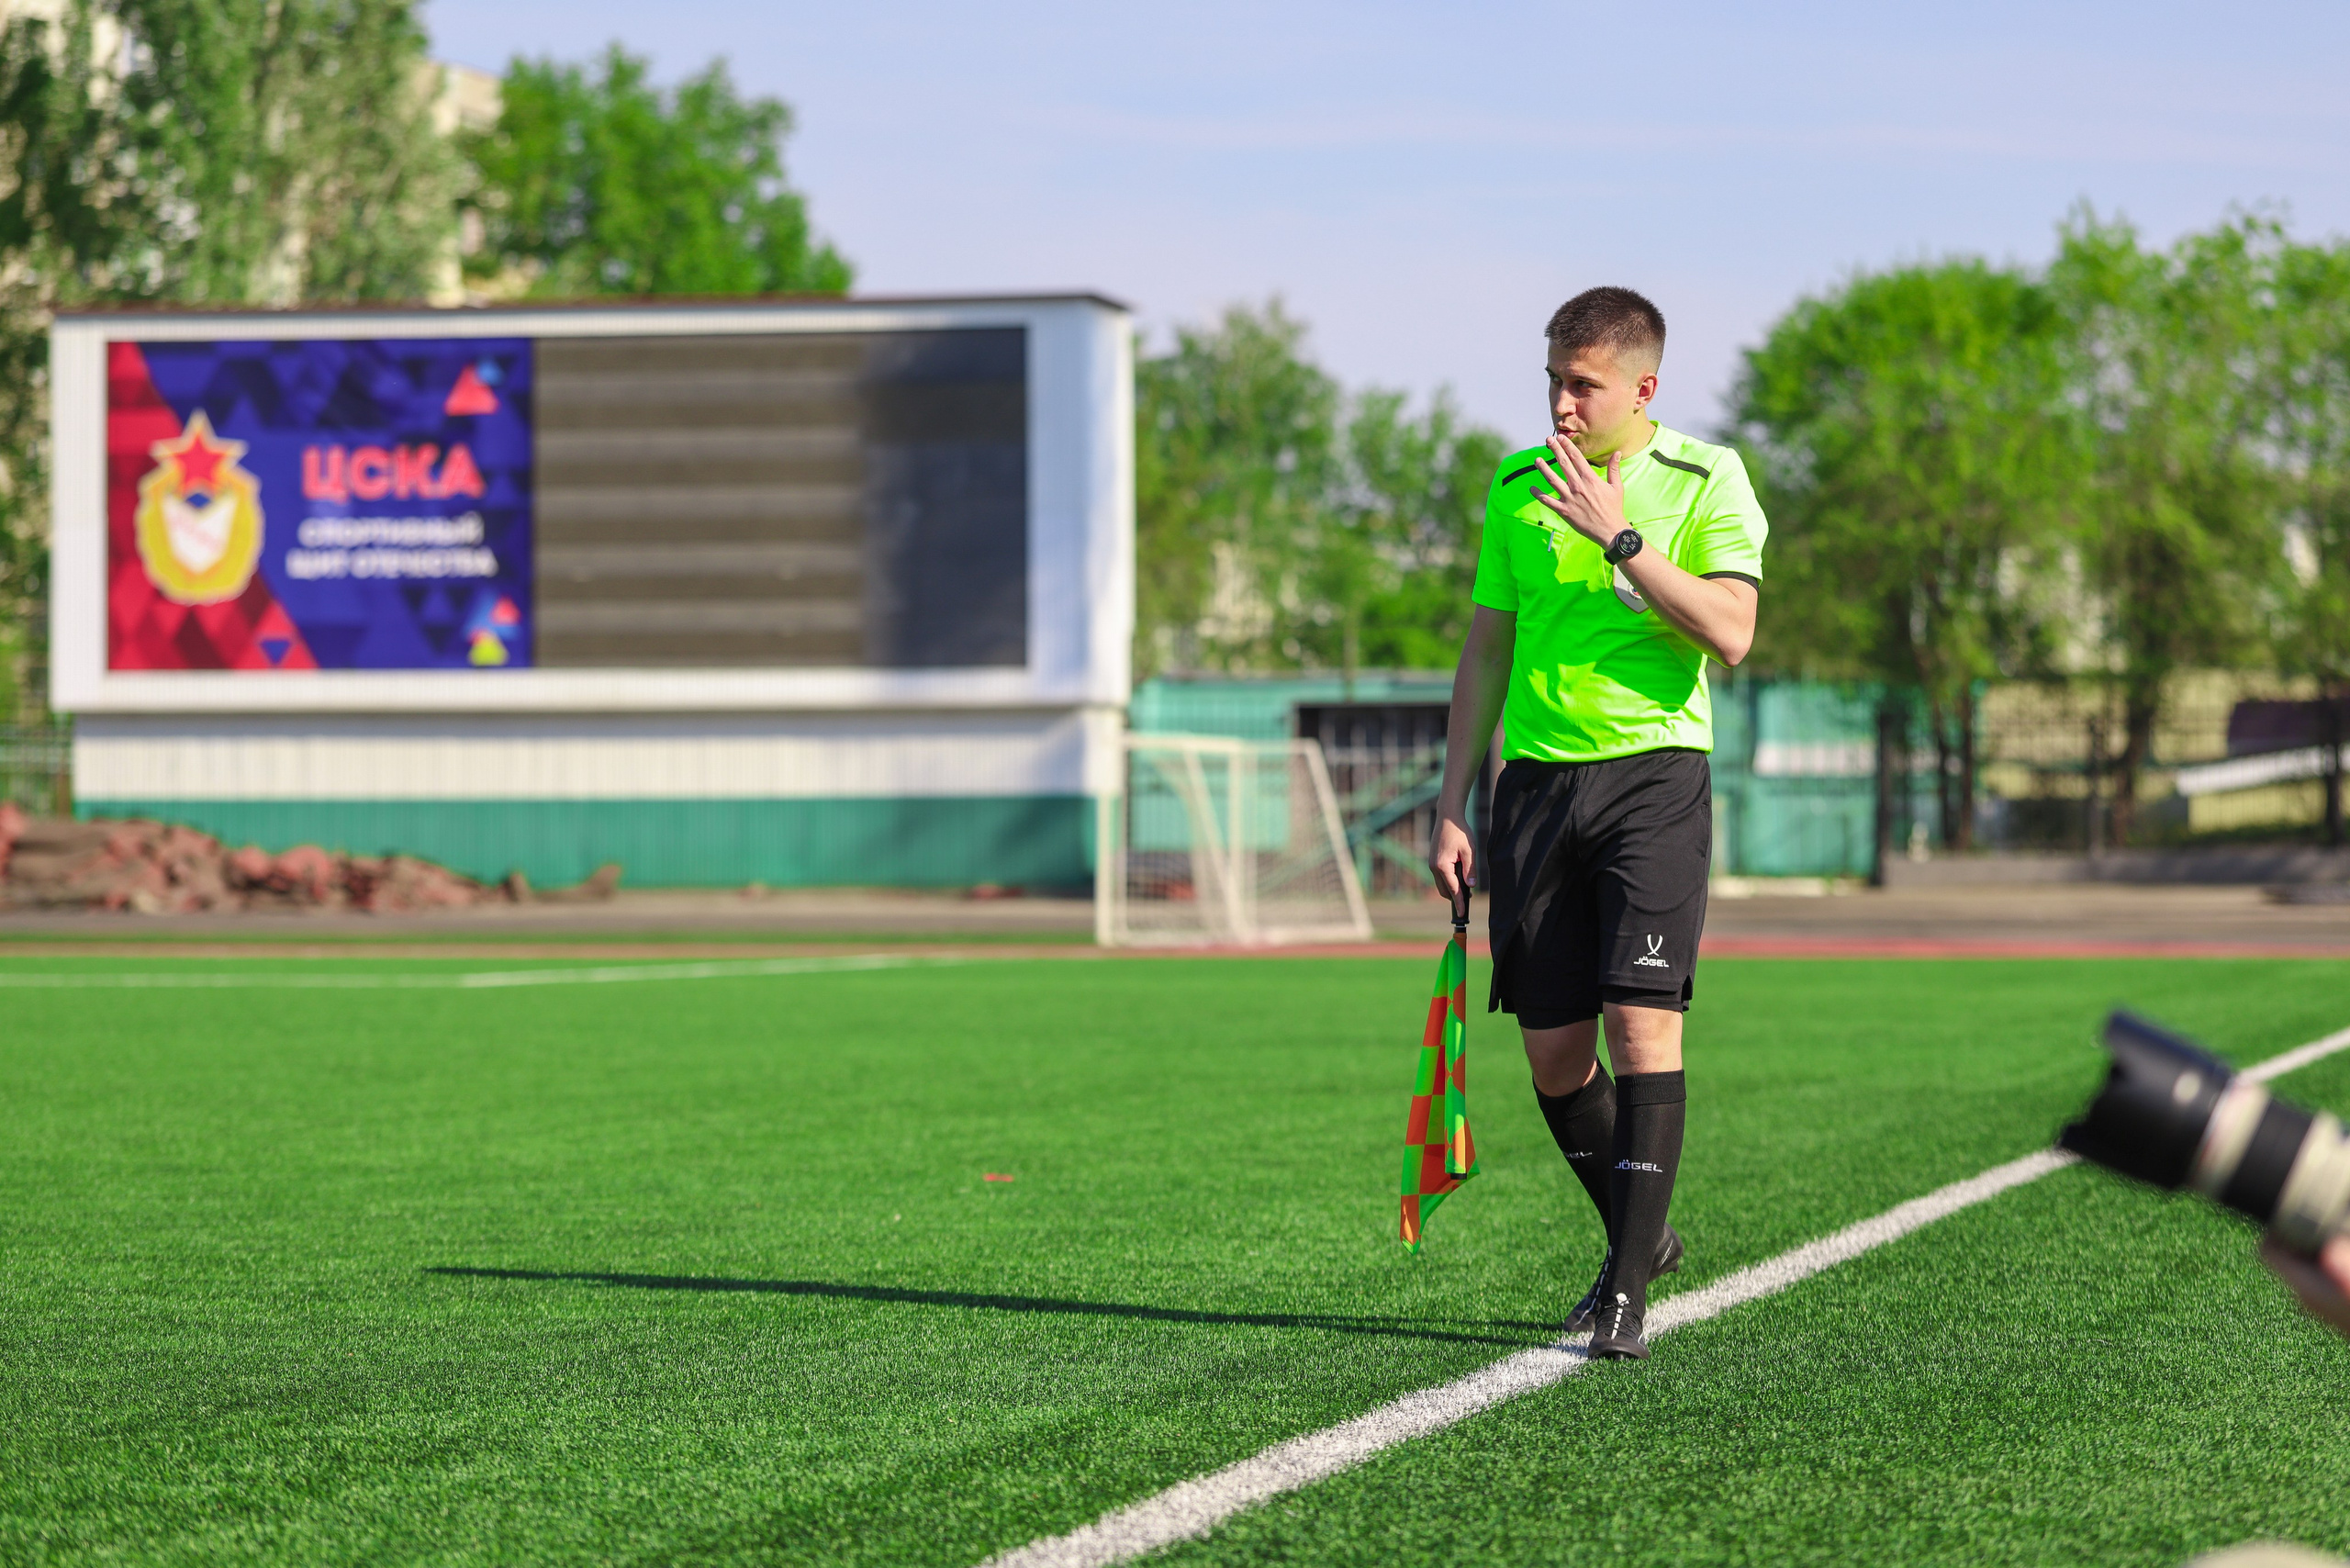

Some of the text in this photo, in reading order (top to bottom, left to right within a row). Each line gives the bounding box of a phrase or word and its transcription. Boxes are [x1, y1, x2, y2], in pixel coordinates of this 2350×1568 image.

[302, 442, 486, 505] ЦСКА
[1633, 956, 1670, 968] JÖGEL
[1615, 1159, 1663, 1172] JÖGEL
